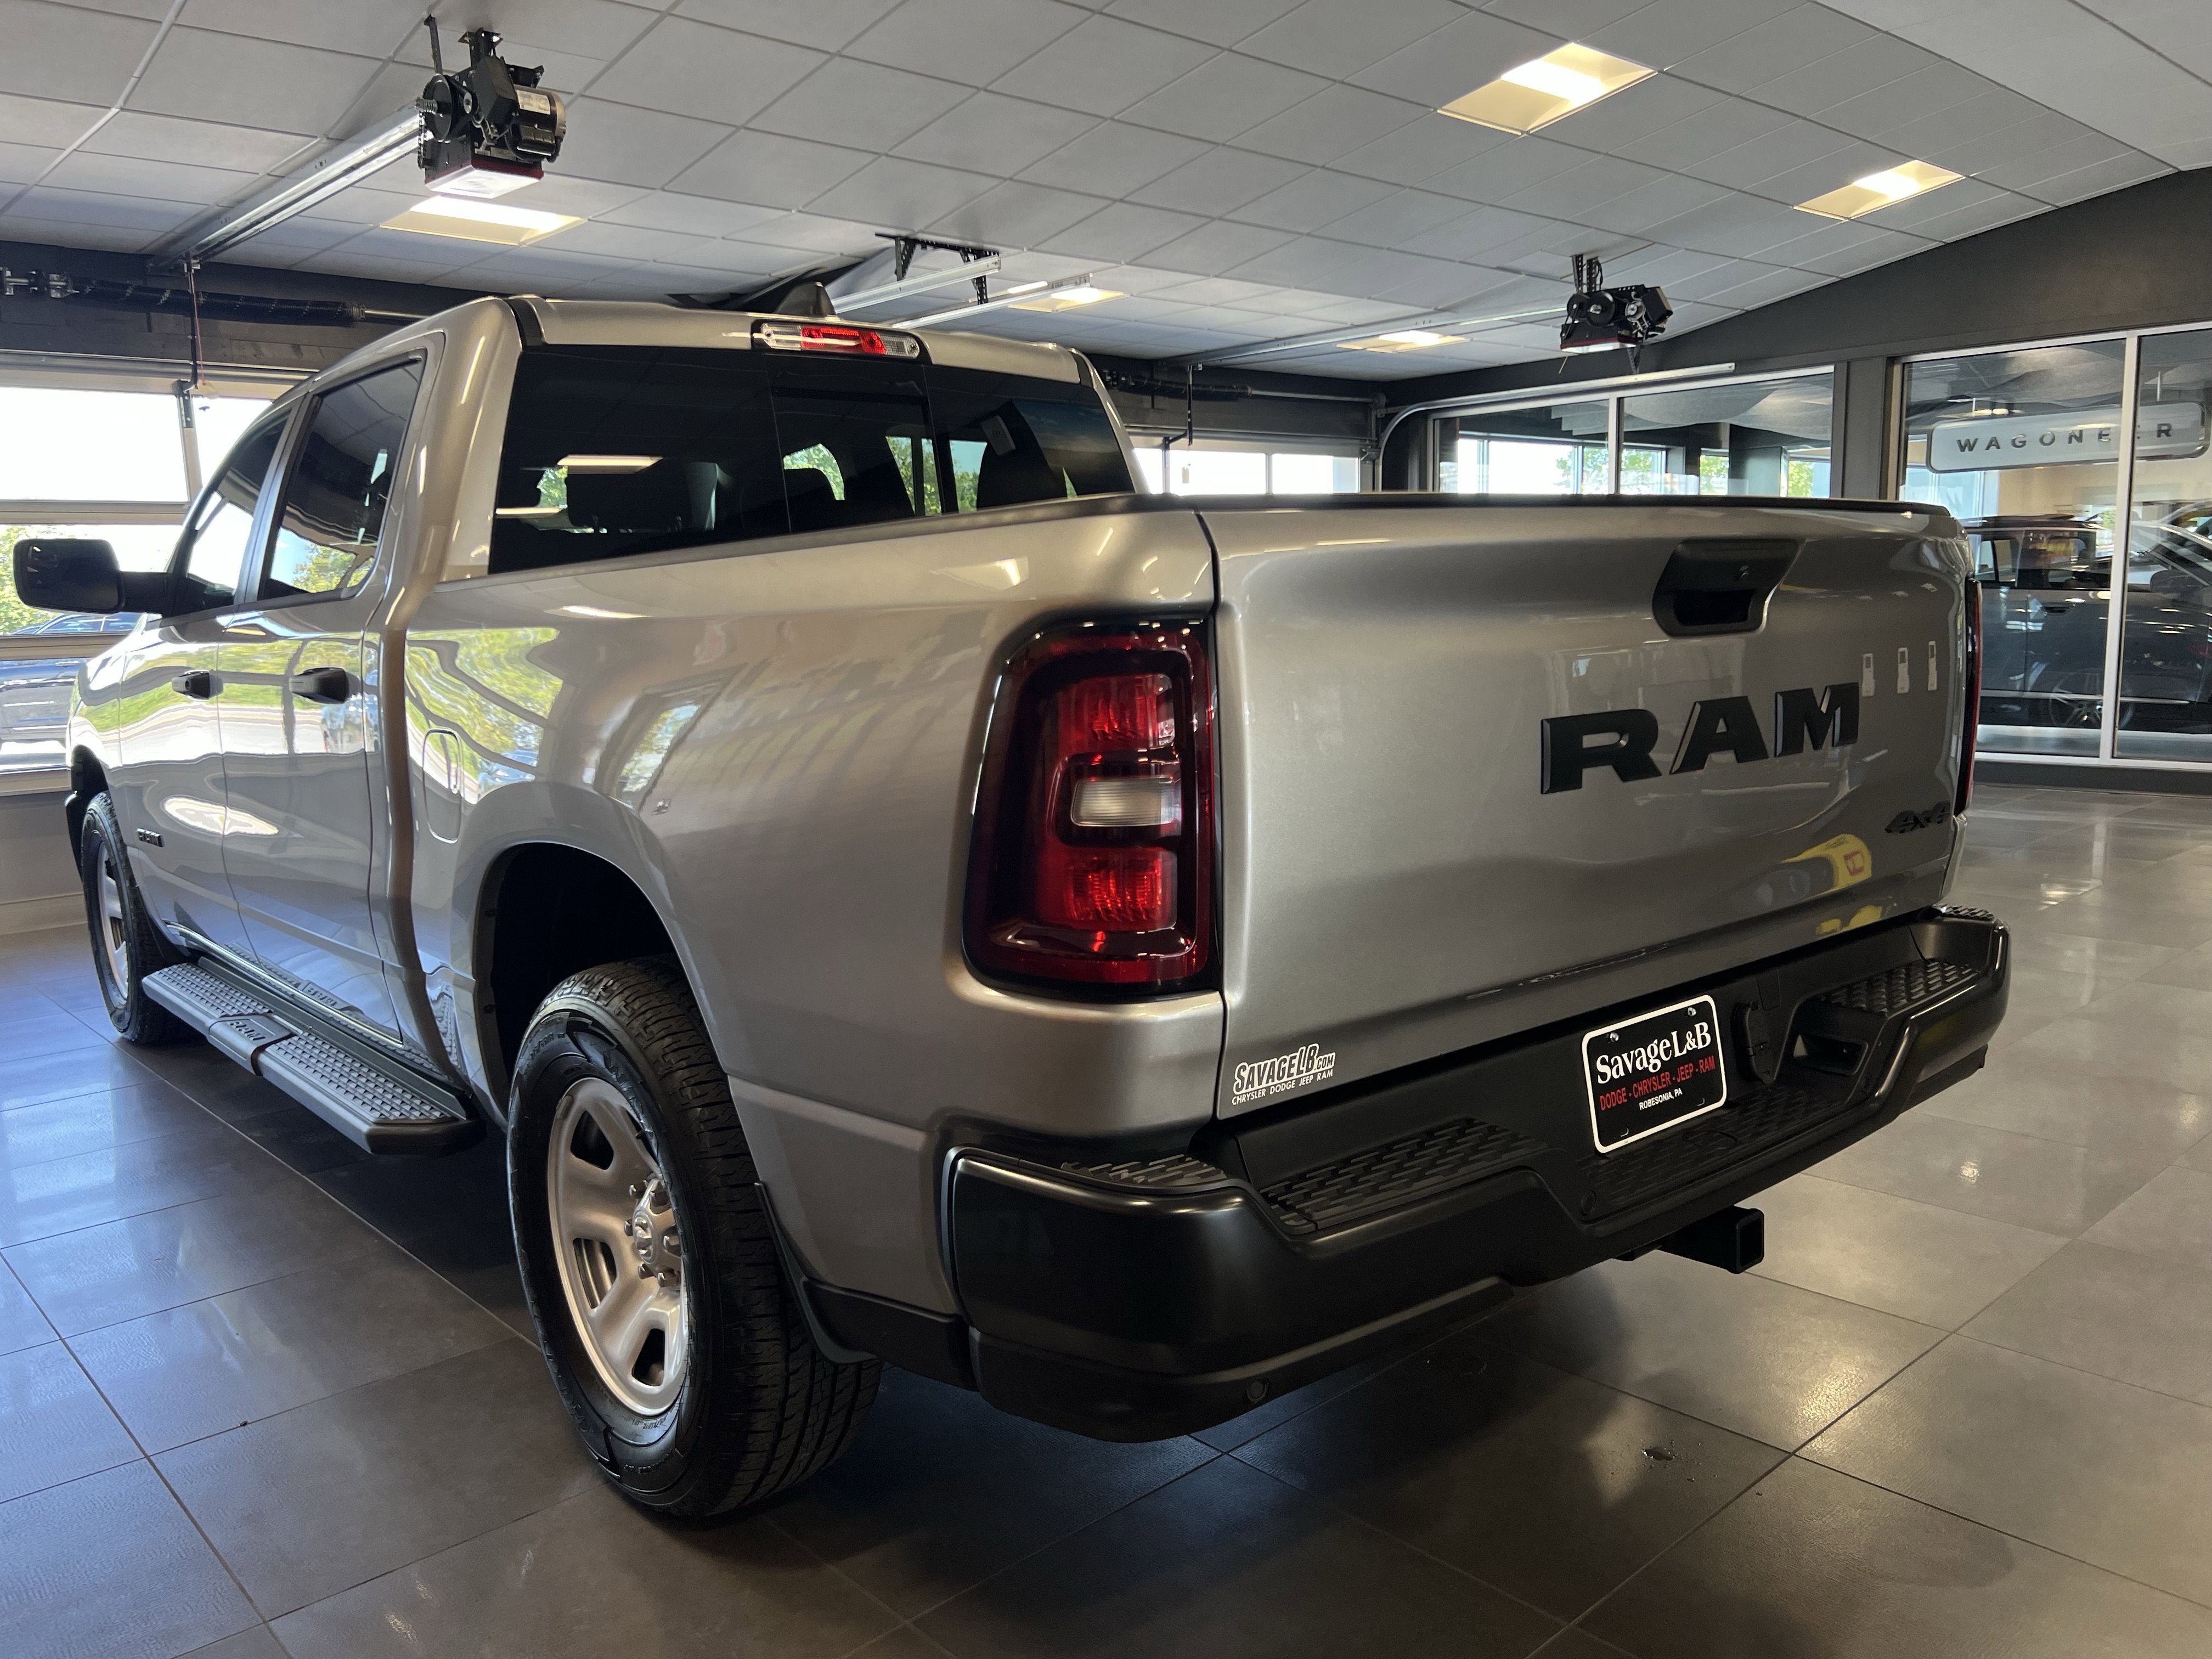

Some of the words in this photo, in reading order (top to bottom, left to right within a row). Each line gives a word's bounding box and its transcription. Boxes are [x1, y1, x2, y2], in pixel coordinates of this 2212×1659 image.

[1957, 423, 2172, 453] WAGONER
[1541, 681, 1860, 795] RAM
[1232, 1088, 1266, 1105] CHRYSLER
[1270, 1079, 1295, 1094] DODGE
[1299, 1074, 1313, 1086] JEEP
[1317, 1069, 1333, 1081] RAM
[1600, 1087, 1628, 1111] DODGE
[1632, 1071, 1671, 1098] CHRYSLER
[1677, 1063, 1694, 1082] JEEP
[1699, 1056, 1716, 1074] RAM
[1639, 1091, 1674, 1110] ROBESONIA,
[1674, 1087, 1683, 1097] PA
